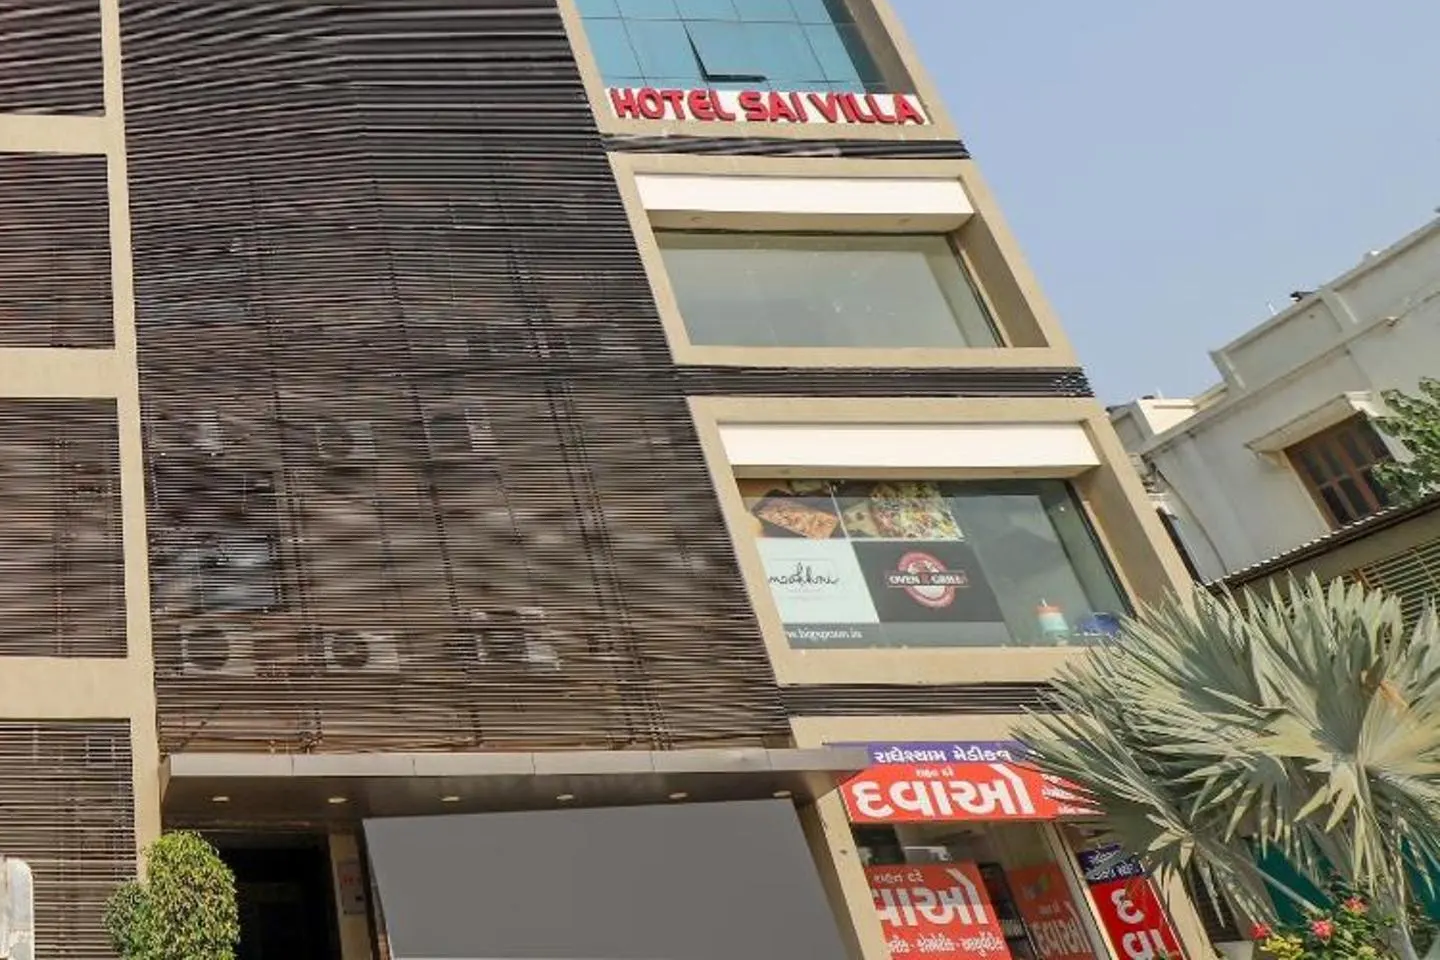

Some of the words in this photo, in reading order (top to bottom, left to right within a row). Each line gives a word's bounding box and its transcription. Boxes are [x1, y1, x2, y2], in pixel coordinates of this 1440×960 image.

[610, 87, 736, 121] HOTEL
[738, 89, 808, 124] SAI
[808, 91, 925, 126] VILLA
[851, 763, 1037, 818] દવાઓ
